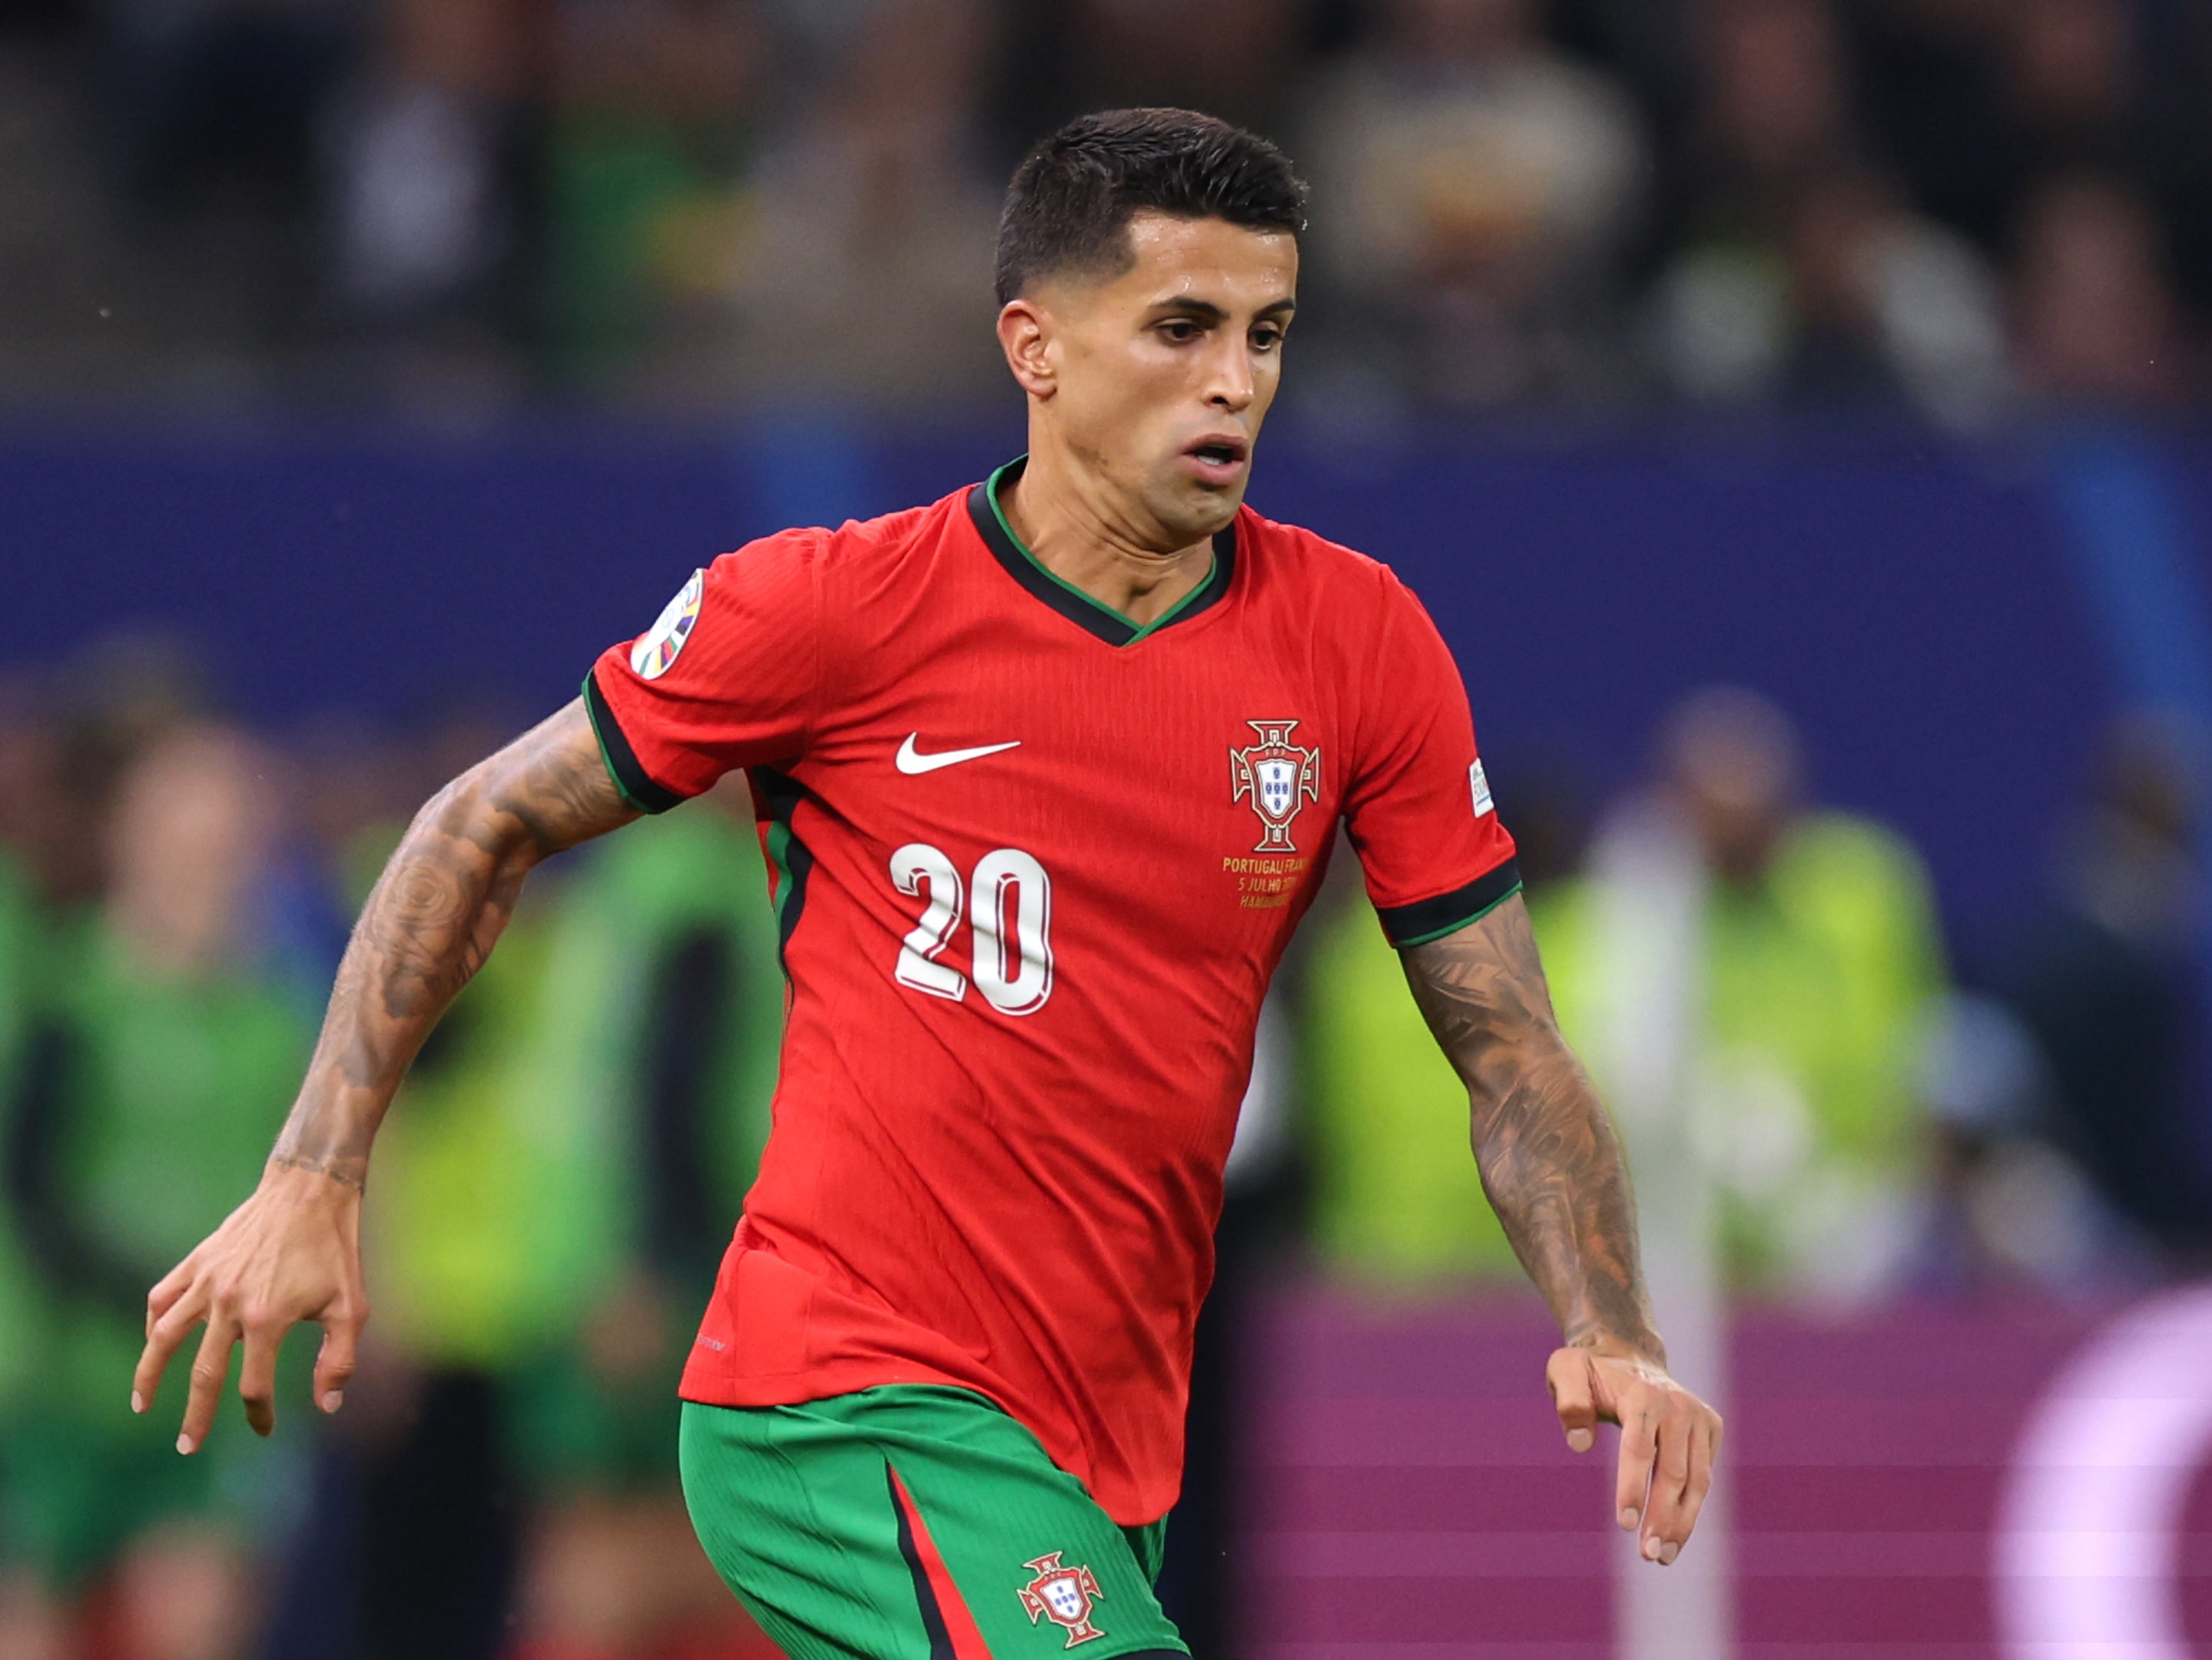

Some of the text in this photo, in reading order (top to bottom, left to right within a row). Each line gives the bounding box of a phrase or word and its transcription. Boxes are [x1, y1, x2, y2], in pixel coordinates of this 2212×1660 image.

[890, 843, 1053, 1016] 20
[1238, 877, 1245, 891] 5
[1248, 877, 1282, 892] JULHO
